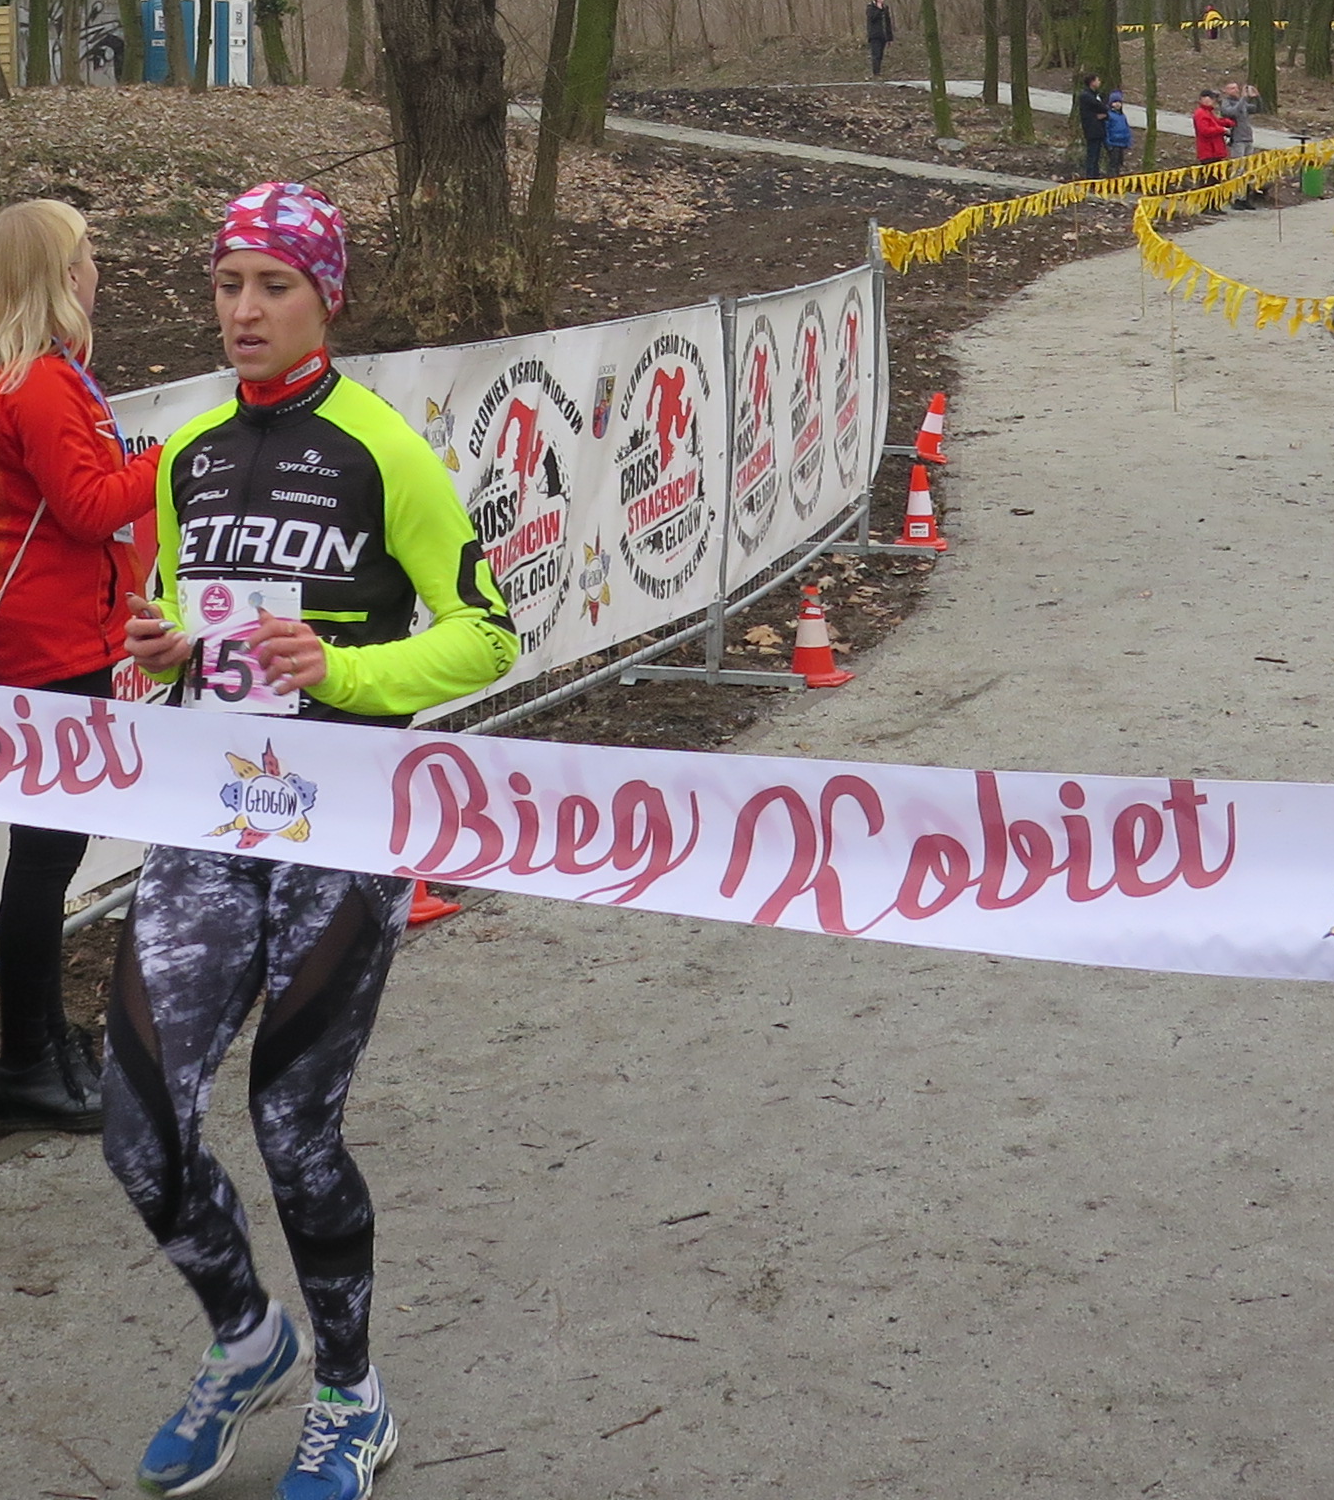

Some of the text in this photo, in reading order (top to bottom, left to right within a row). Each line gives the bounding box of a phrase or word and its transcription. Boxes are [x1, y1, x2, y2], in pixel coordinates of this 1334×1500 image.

[468, 372, 510, 459] CZŁOWIEK
[271, 490, 337, 509] SHIMANO
[620, 449, 660, 506] CROSS
[520, 627, 542, 656] THE
[245, 785, 298, 817] GŁOGÓW
[389, 741, 1236, 937] Bieg Kobiet
